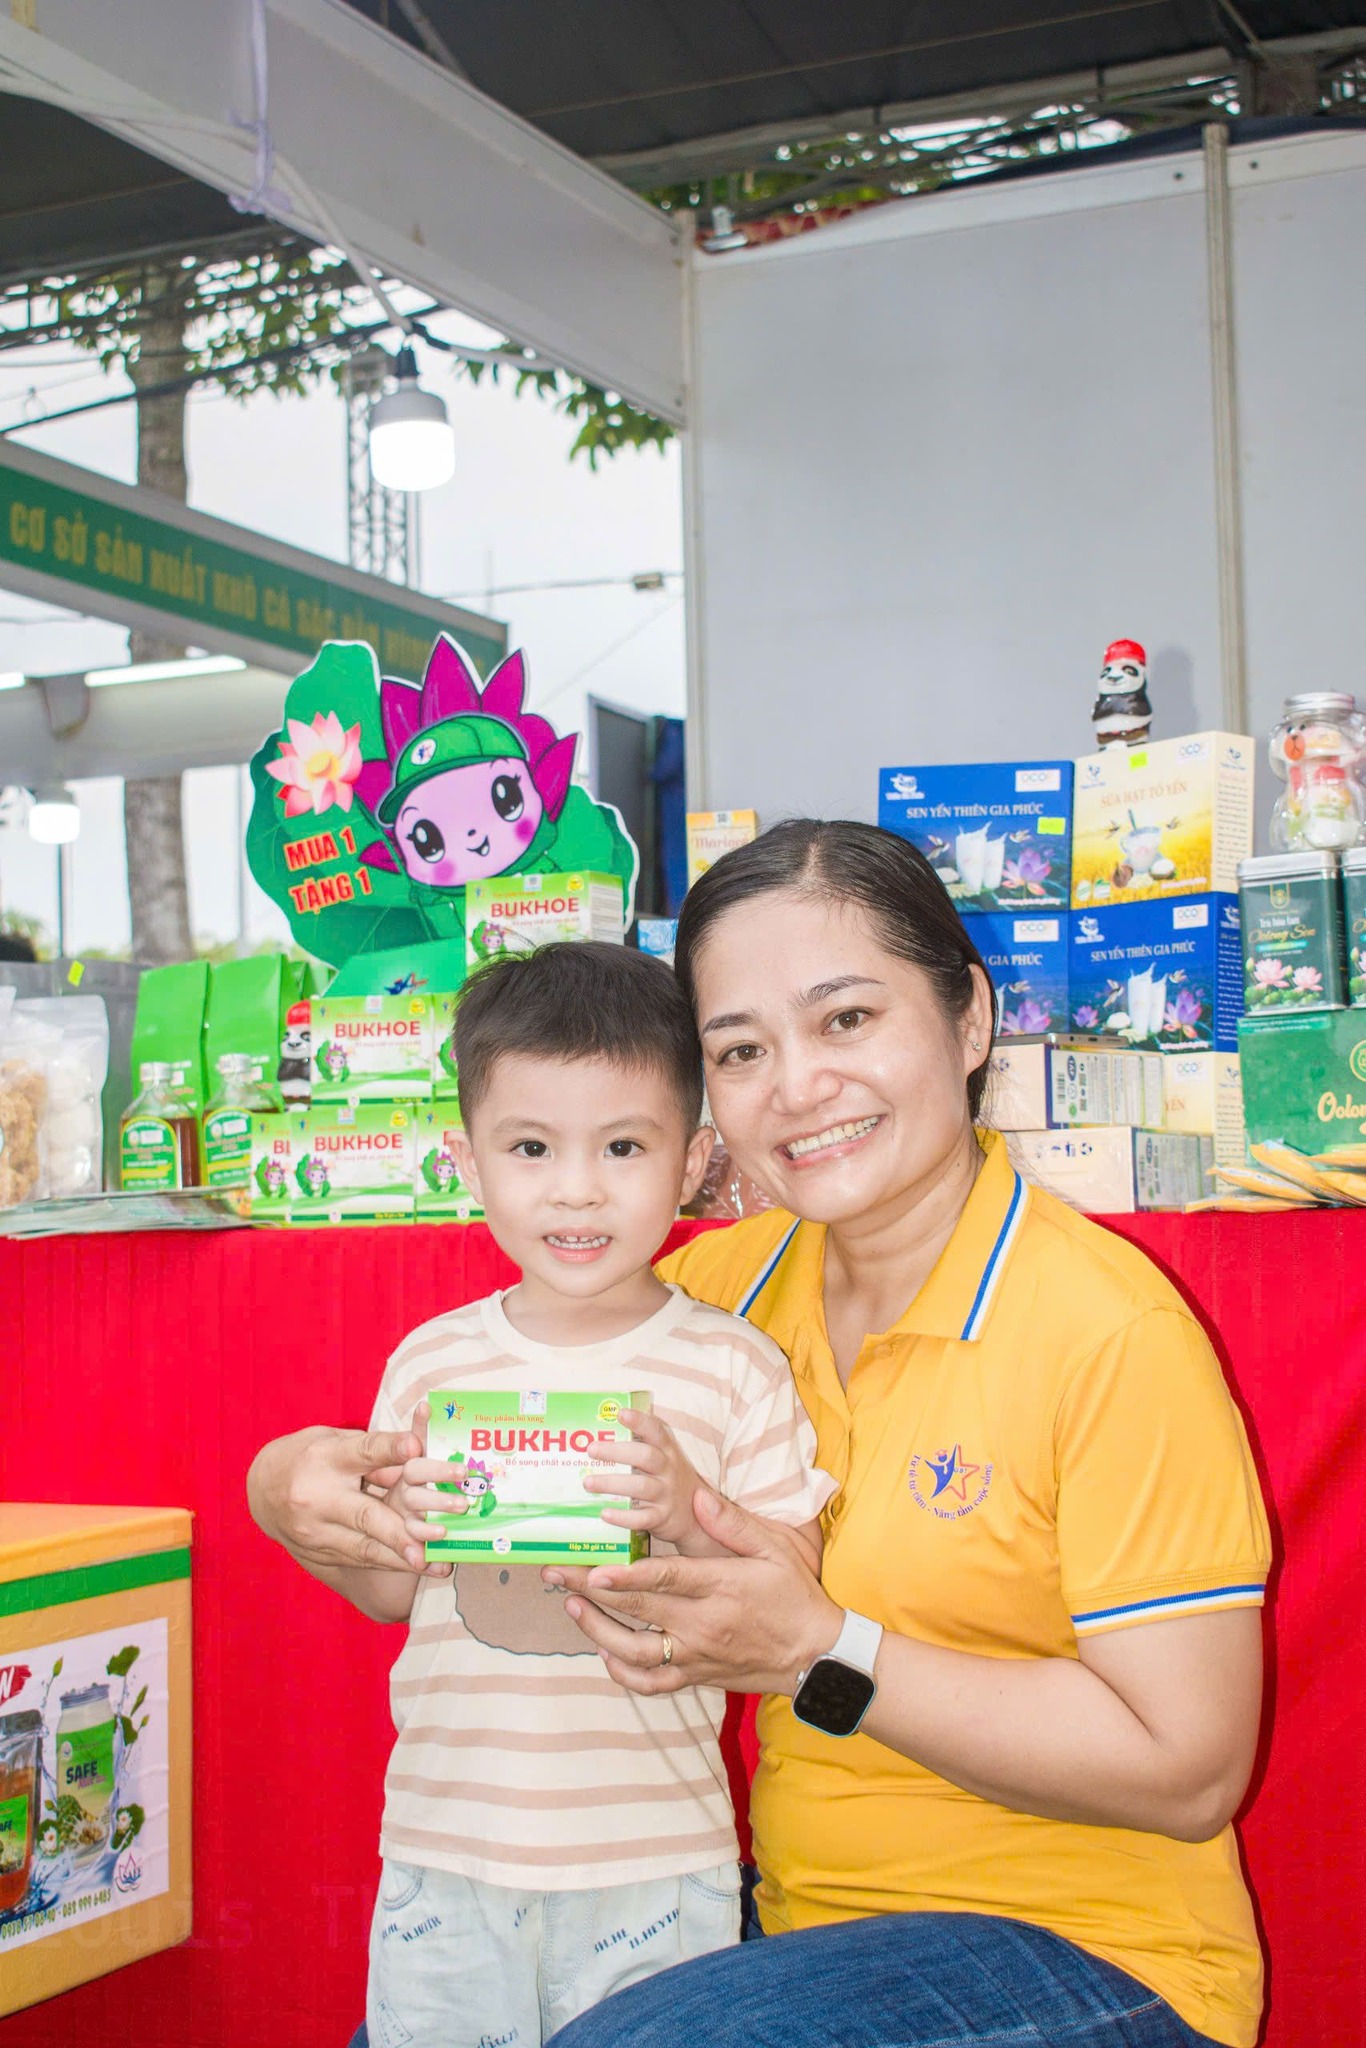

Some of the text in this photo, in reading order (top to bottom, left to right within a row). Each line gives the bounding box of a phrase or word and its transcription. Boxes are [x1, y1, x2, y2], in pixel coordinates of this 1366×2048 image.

[907, 801, 1044, 819] SEN YẾN THIÊN GIA PHÚC
[284, 826, 357, 871] MUA 1
[289, 867, 373, 915] TẶNG 1
[491, 897, 580, 918] BUKHOE
[988, 951, 1043, 966] GIA PHÚC
[1091, 951, 1107, 962] SEN
[1153, 945, 1170, 956] GIA
[335, 1020, 421, 1038] BUKHOE
[315, 1133, 403, 1152] BUKHOE
[519, 1460, 539, 1468] sung
[573, 1459, 588, 1467] cho
[66, 1760, 98, 1785] SAFE
